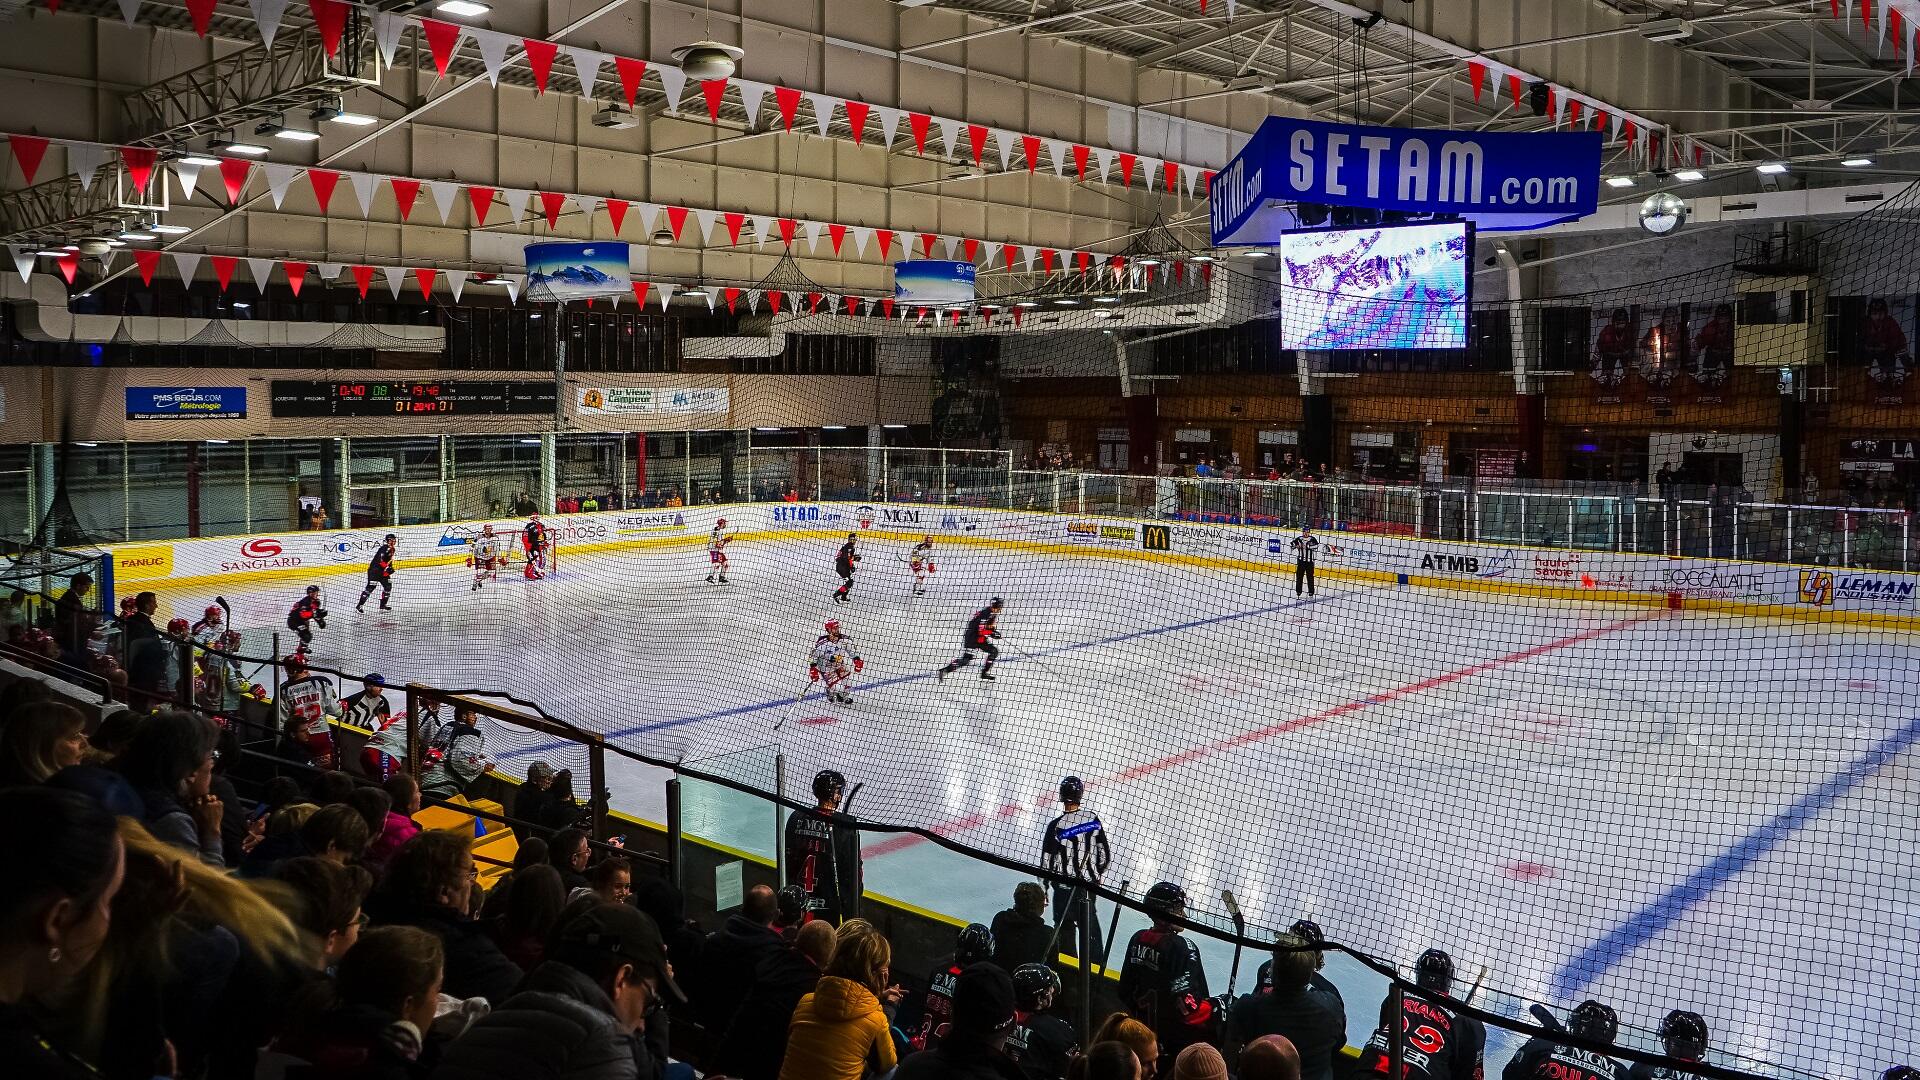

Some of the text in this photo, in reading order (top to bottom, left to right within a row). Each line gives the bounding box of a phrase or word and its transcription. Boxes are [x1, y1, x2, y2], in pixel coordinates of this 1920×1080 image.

[1289, 129, 1578, 205] SETAM.com
[883, 509, 920, 523] MGM
[121, 557, 164, 568] FANUC
[220, 557, 301, 572] SANGLARD
[1421, 553, 1479, 573] ATMB
[1838, 577, 1914, 594] LEMAN
[1570, 1046, 1618, 1077] MGM
